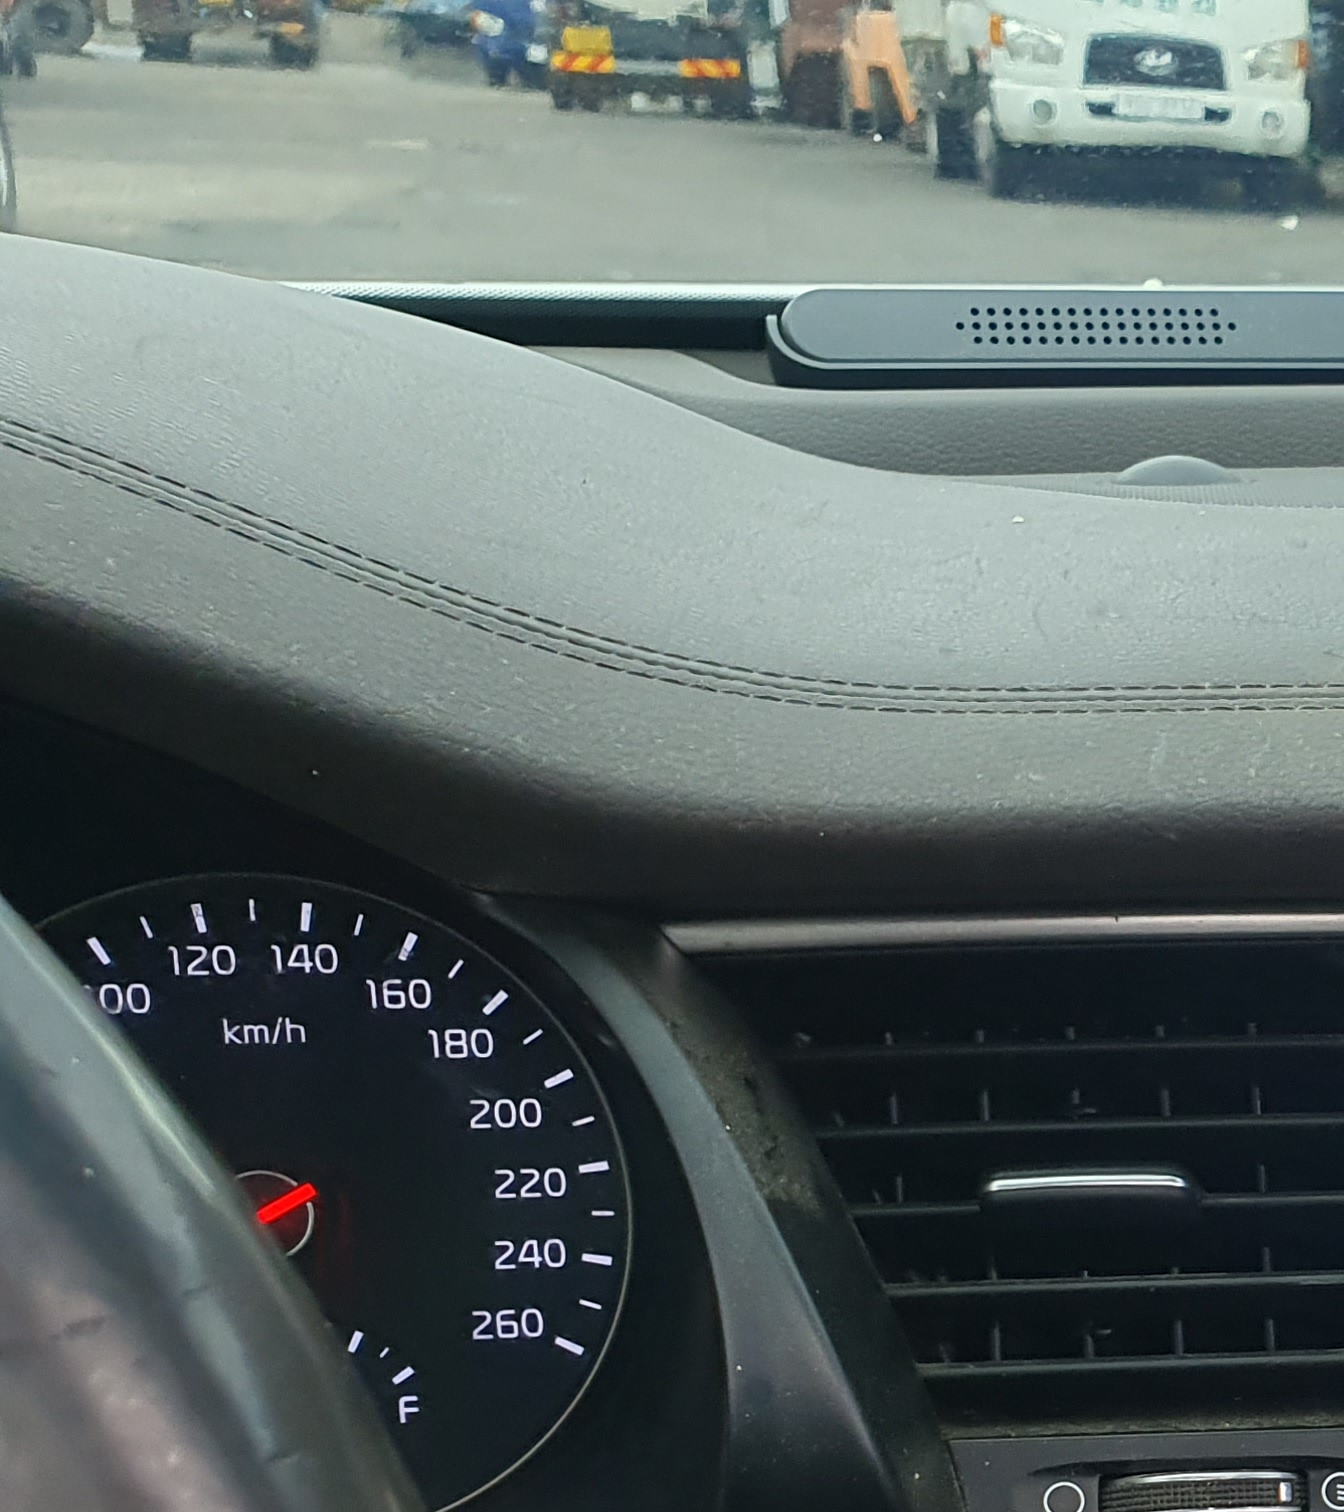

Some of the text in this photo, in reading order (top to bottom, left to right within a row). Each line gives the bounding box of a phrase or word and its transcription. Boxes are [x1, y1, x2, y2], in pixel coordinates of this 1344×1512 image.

[168, 944, 236, 977] 120
[271, 942, 339, 975] 140
[83, 984, 151, 1014] 00
[366, 978, 431, 1010] 160
[223, 1018, 307, 1045] km/h
[428, 1028, 494, 1060] 180
[469, 1099, 542, 1130] 200
[494, 1167, 566, 1199] 220
[494, 1238, 566, 1270] 240
[471, 1308, 544, 1341] 260
[398, 1396, 420, 1424] F
